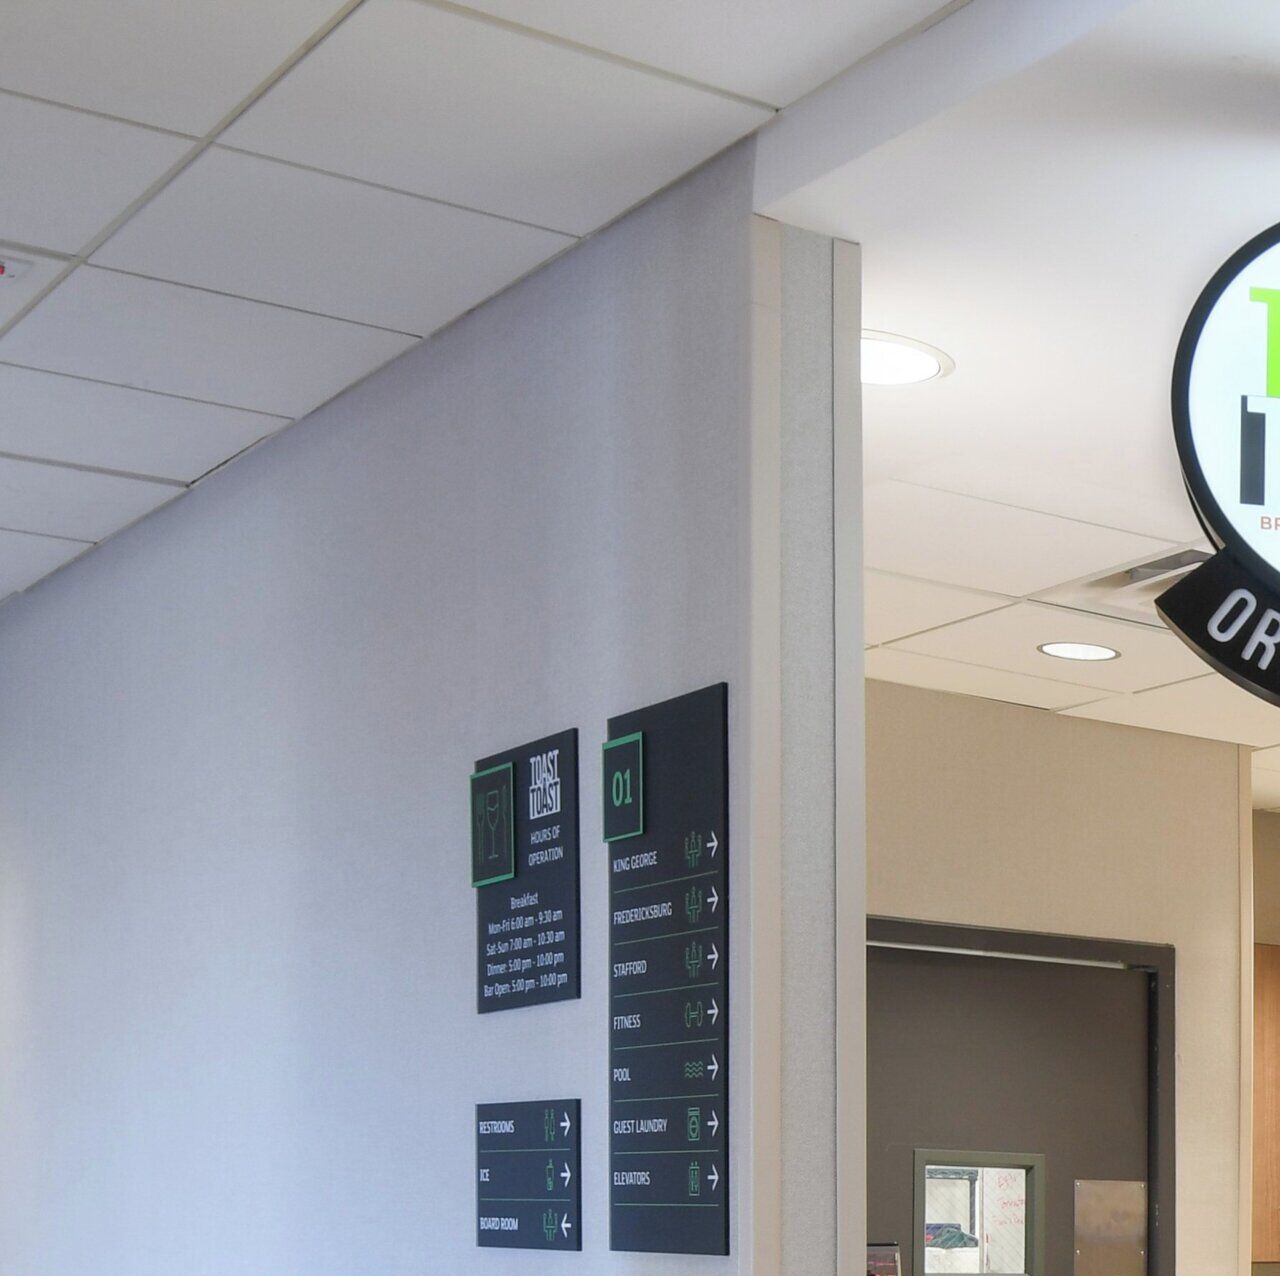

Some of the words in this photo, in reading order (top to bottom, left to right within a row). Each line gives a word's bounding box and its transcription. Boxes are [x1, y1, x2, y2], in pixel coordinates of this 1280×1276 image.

[530, 749, 560, 787] TOAST
[612, 768, 632, 807] 01
[530, 781, 560, 818] TOAST
[530, 828, 551, 844] HOURS
[552, 825, 560, 839] OF
[528, 846, 563, 866] OPERATION
[613, 857, 630, 872] KING
[631, 850, 658, 870] GEORGE
[511, 892, 538, 910] Breakfast
[488, 918, 510, 934] Mon-Fri
[511, 916, 523, 930] 6:00
[524, 916, 534, 927] am
[539, 910, 551, 924] 9:30
[553, 910, 563, 921] am
[613, 902, 672, 925] FREDERICKSBURG
[486, 941, 509, 956] Sat-Sun
[510, 937, 522, 951] 7:00
[523, 937, 533, 948] am
[537, 930, 554, 946] 10:30
[555, 930, 565, 942] am
[508, 958, 521, 972] 5:00
[522, 958, 532, 973] pm
[537, 952, 553, 967] 10:00
[554, 952, 564, 967] pm
[613, 960, 647, 978] STAFFORD
[484, 985, 493, 997] Bar
[511, 978, 524, 992] 5:00
[525, 979, 535, 993] pm
[540, 973, 556, 987] 10:00
[557, 973, 567, 987] pm
[613, 1014, 641, 1030] FITNESS
[613, 1068, 631, 1082] POOL
[479, 1120, 515, 1133] RESTROOMS
[613, 1120, 636, 1134] GUEST
[636, 1118, 667, 1133] LAUNDRY
[480, 1169, 489, 1181] ICE
[613, 1171, 650, 1186] ELEVATORS
[480, 1217, 500, 1230] BOARD
[500, 1218, 518, 1230] ROOM
